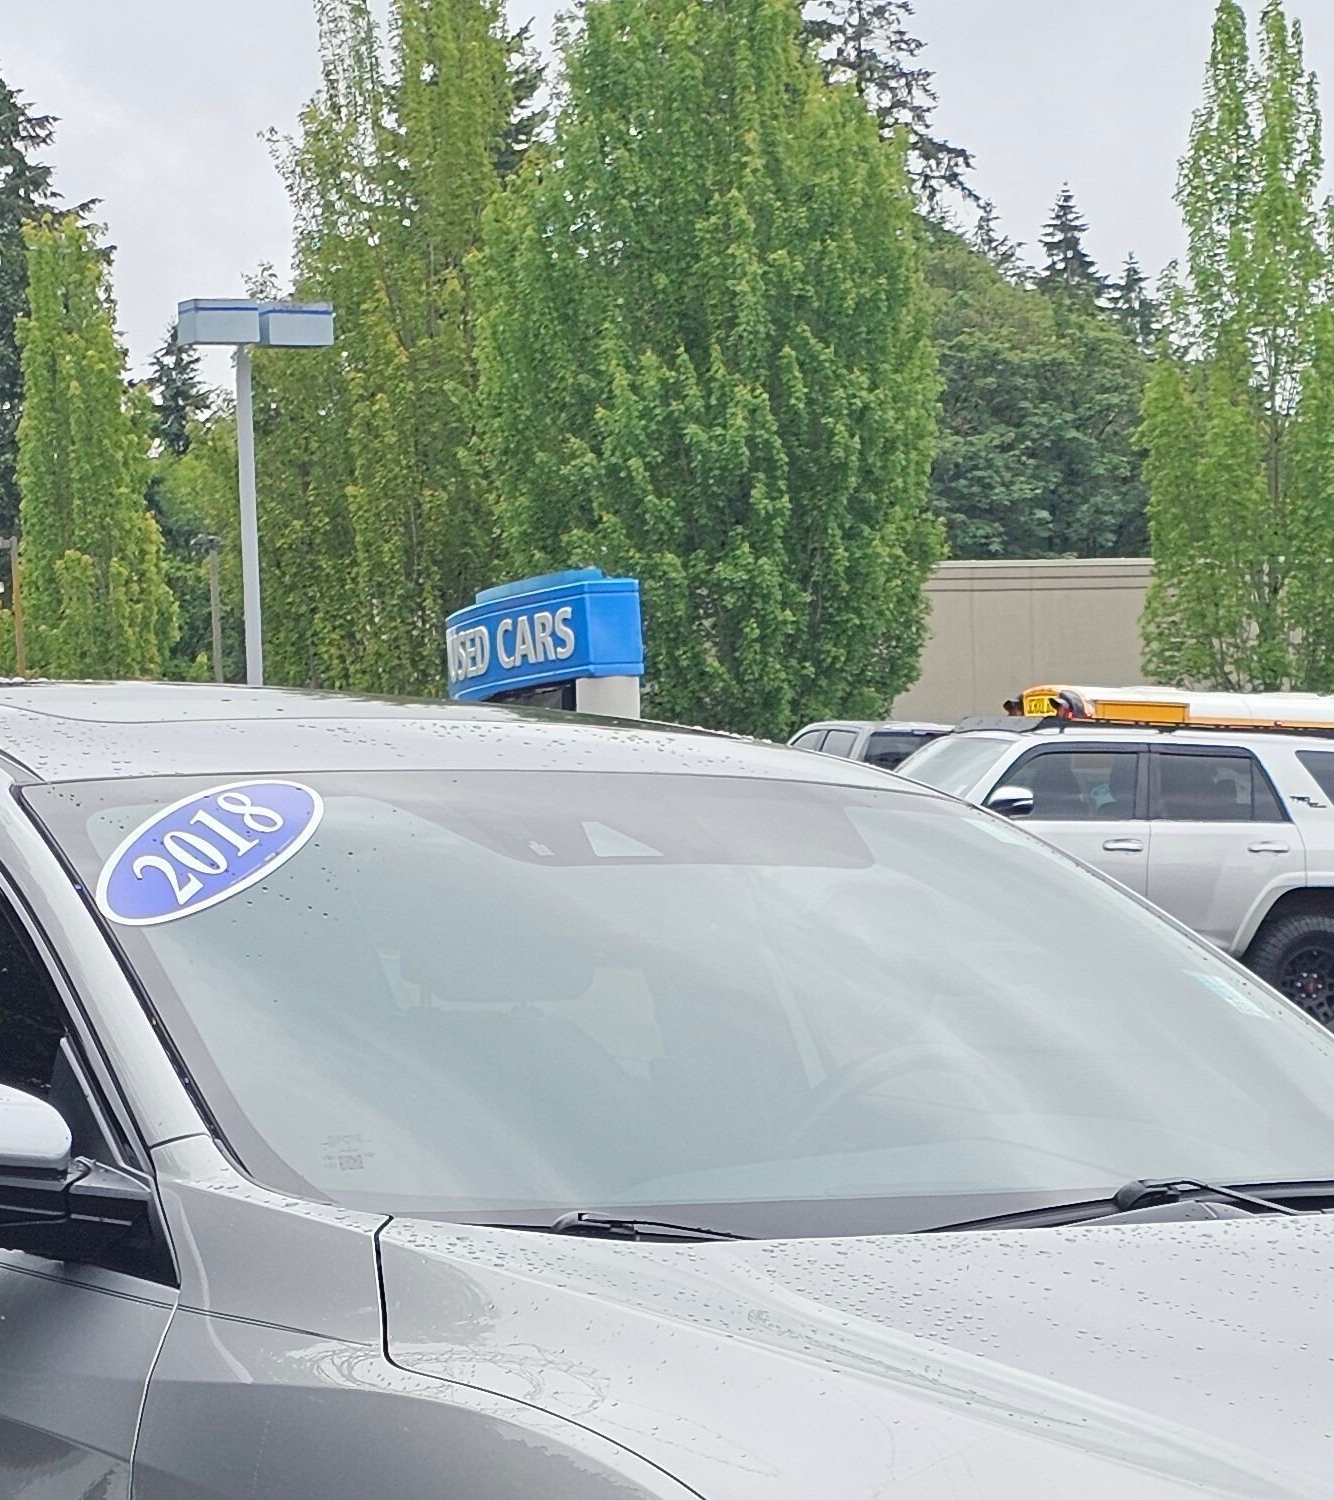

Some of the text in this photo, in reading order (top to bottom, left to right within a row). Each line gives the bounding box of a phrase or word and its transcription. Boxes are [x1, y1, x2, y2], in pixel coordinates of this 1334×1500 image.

[446, 606, 576, 683] USED CARS
[132, 792, 284, 905] 2018
